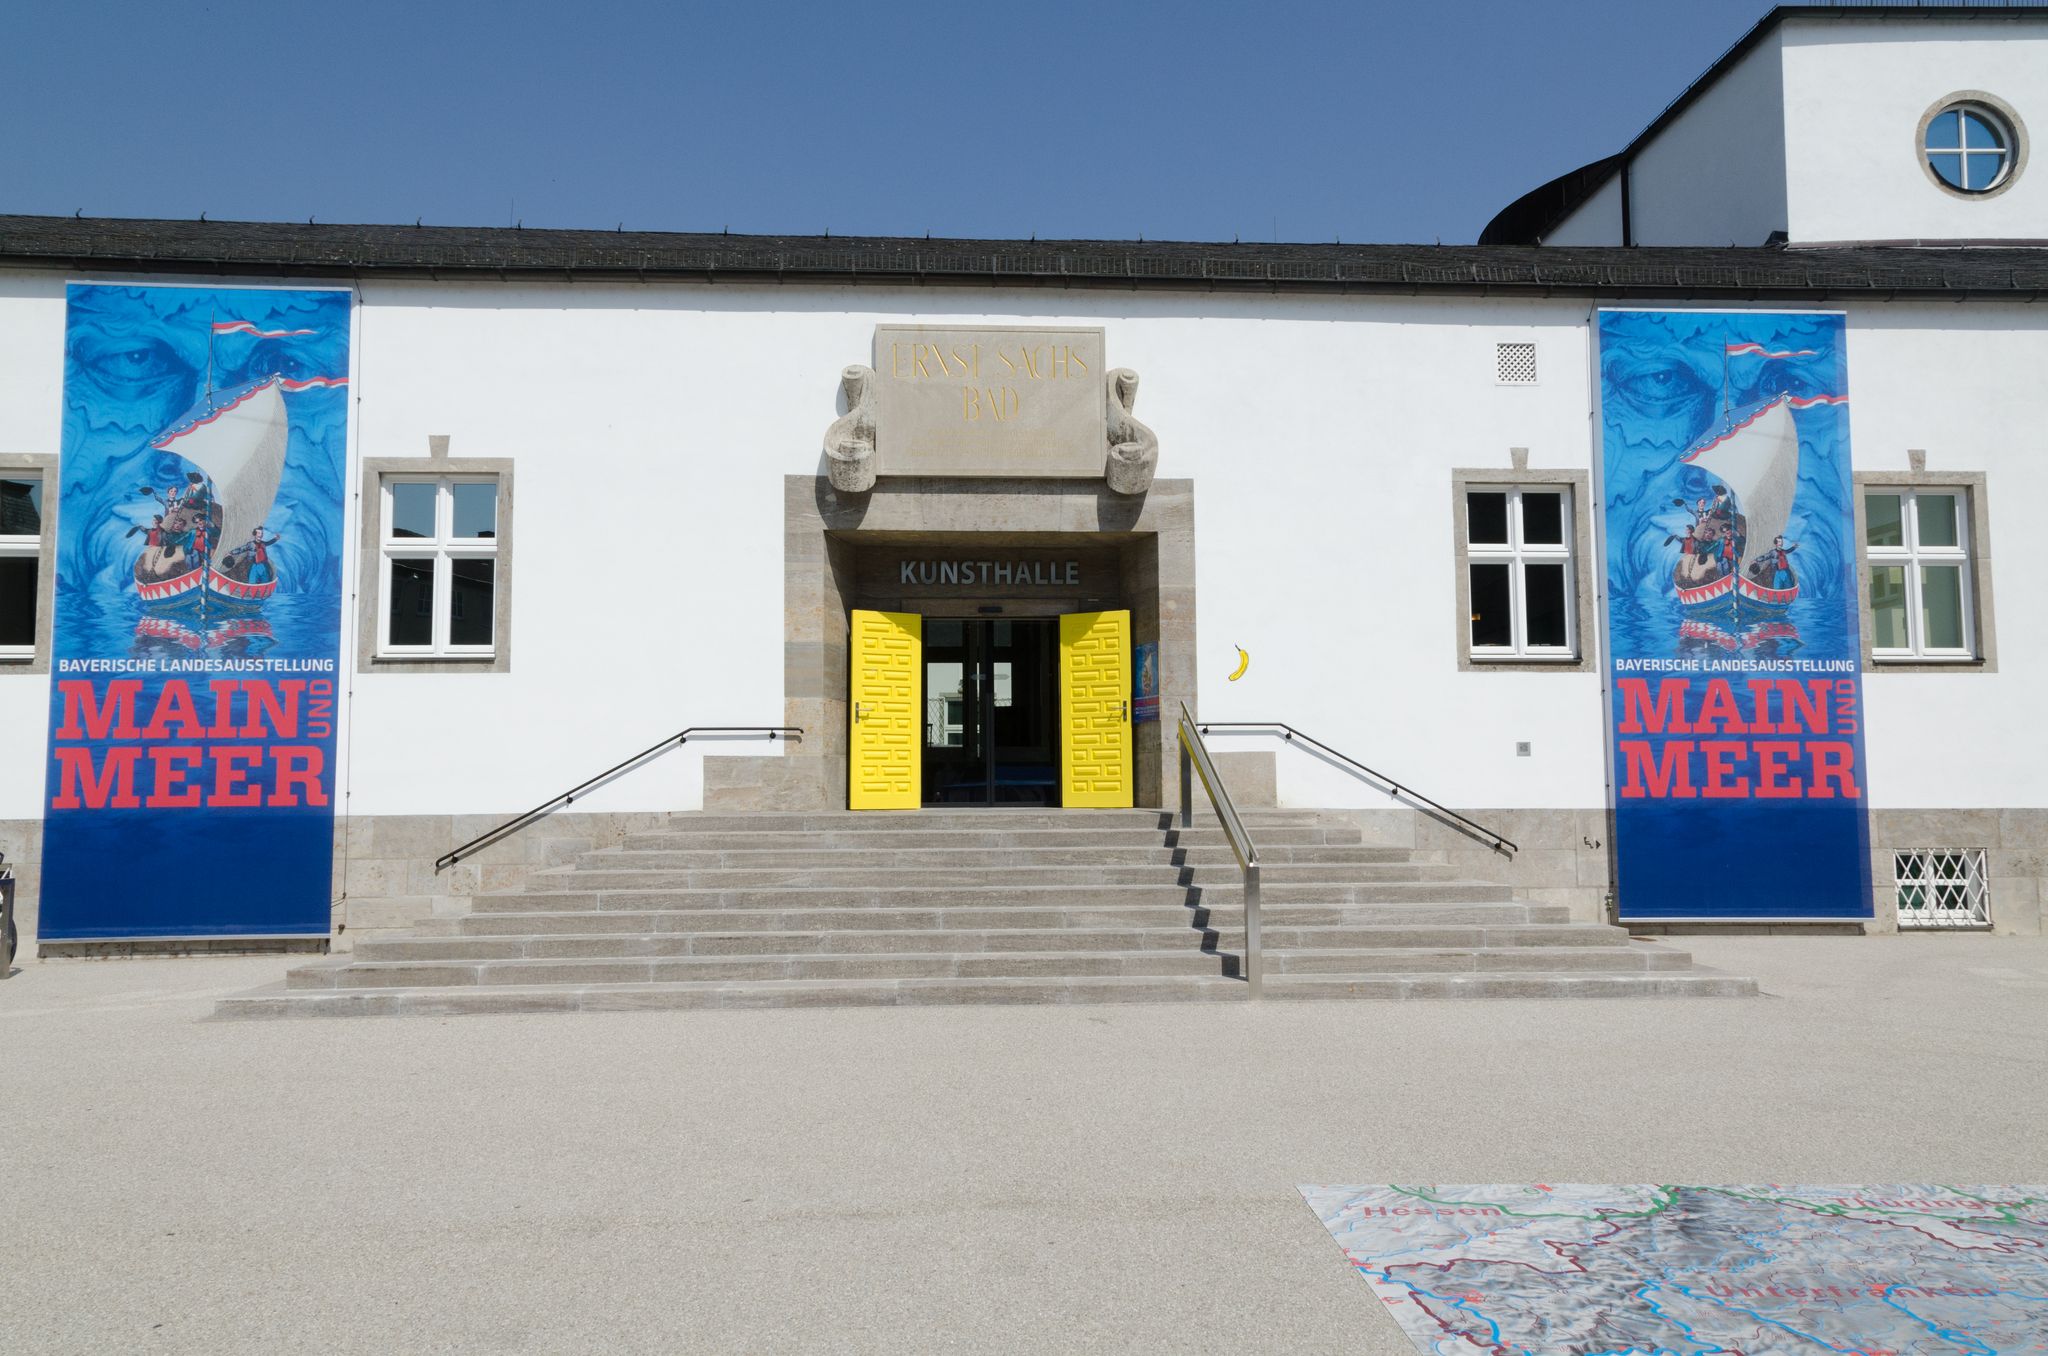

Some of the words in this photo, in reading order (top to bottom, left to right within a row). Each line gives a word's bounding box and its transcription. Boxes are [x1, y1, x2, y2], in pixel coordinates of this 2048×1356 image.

[892, 343, 983, 379] ERNST
[998, 345, 1089, 379] SACHS
[962, 385, 1019, 422] BAD
[900, 560, 1080, 585] KUNSTHALLE
[59, 659, 156, 672] BAYERISCHE
[161, 659, 334, 672] LANDESAUSSTELLUNG
[1616, 659, 1700, 672] BAYERISCHE
[1703, 659, 1855, 672] LANDESAUSSTELLUNG
[55, 679, 306, 740] MAIN
[307, 678, 333, 739] UND
[1617, 678, 1833, 734] MAIN
[1836, 678, 1858, 735] UND
[52, 745, 328, 809] MEER
[1619, 740, 1862, 798] MEER
[1363, 1206, 1502, 1217] Hessen
